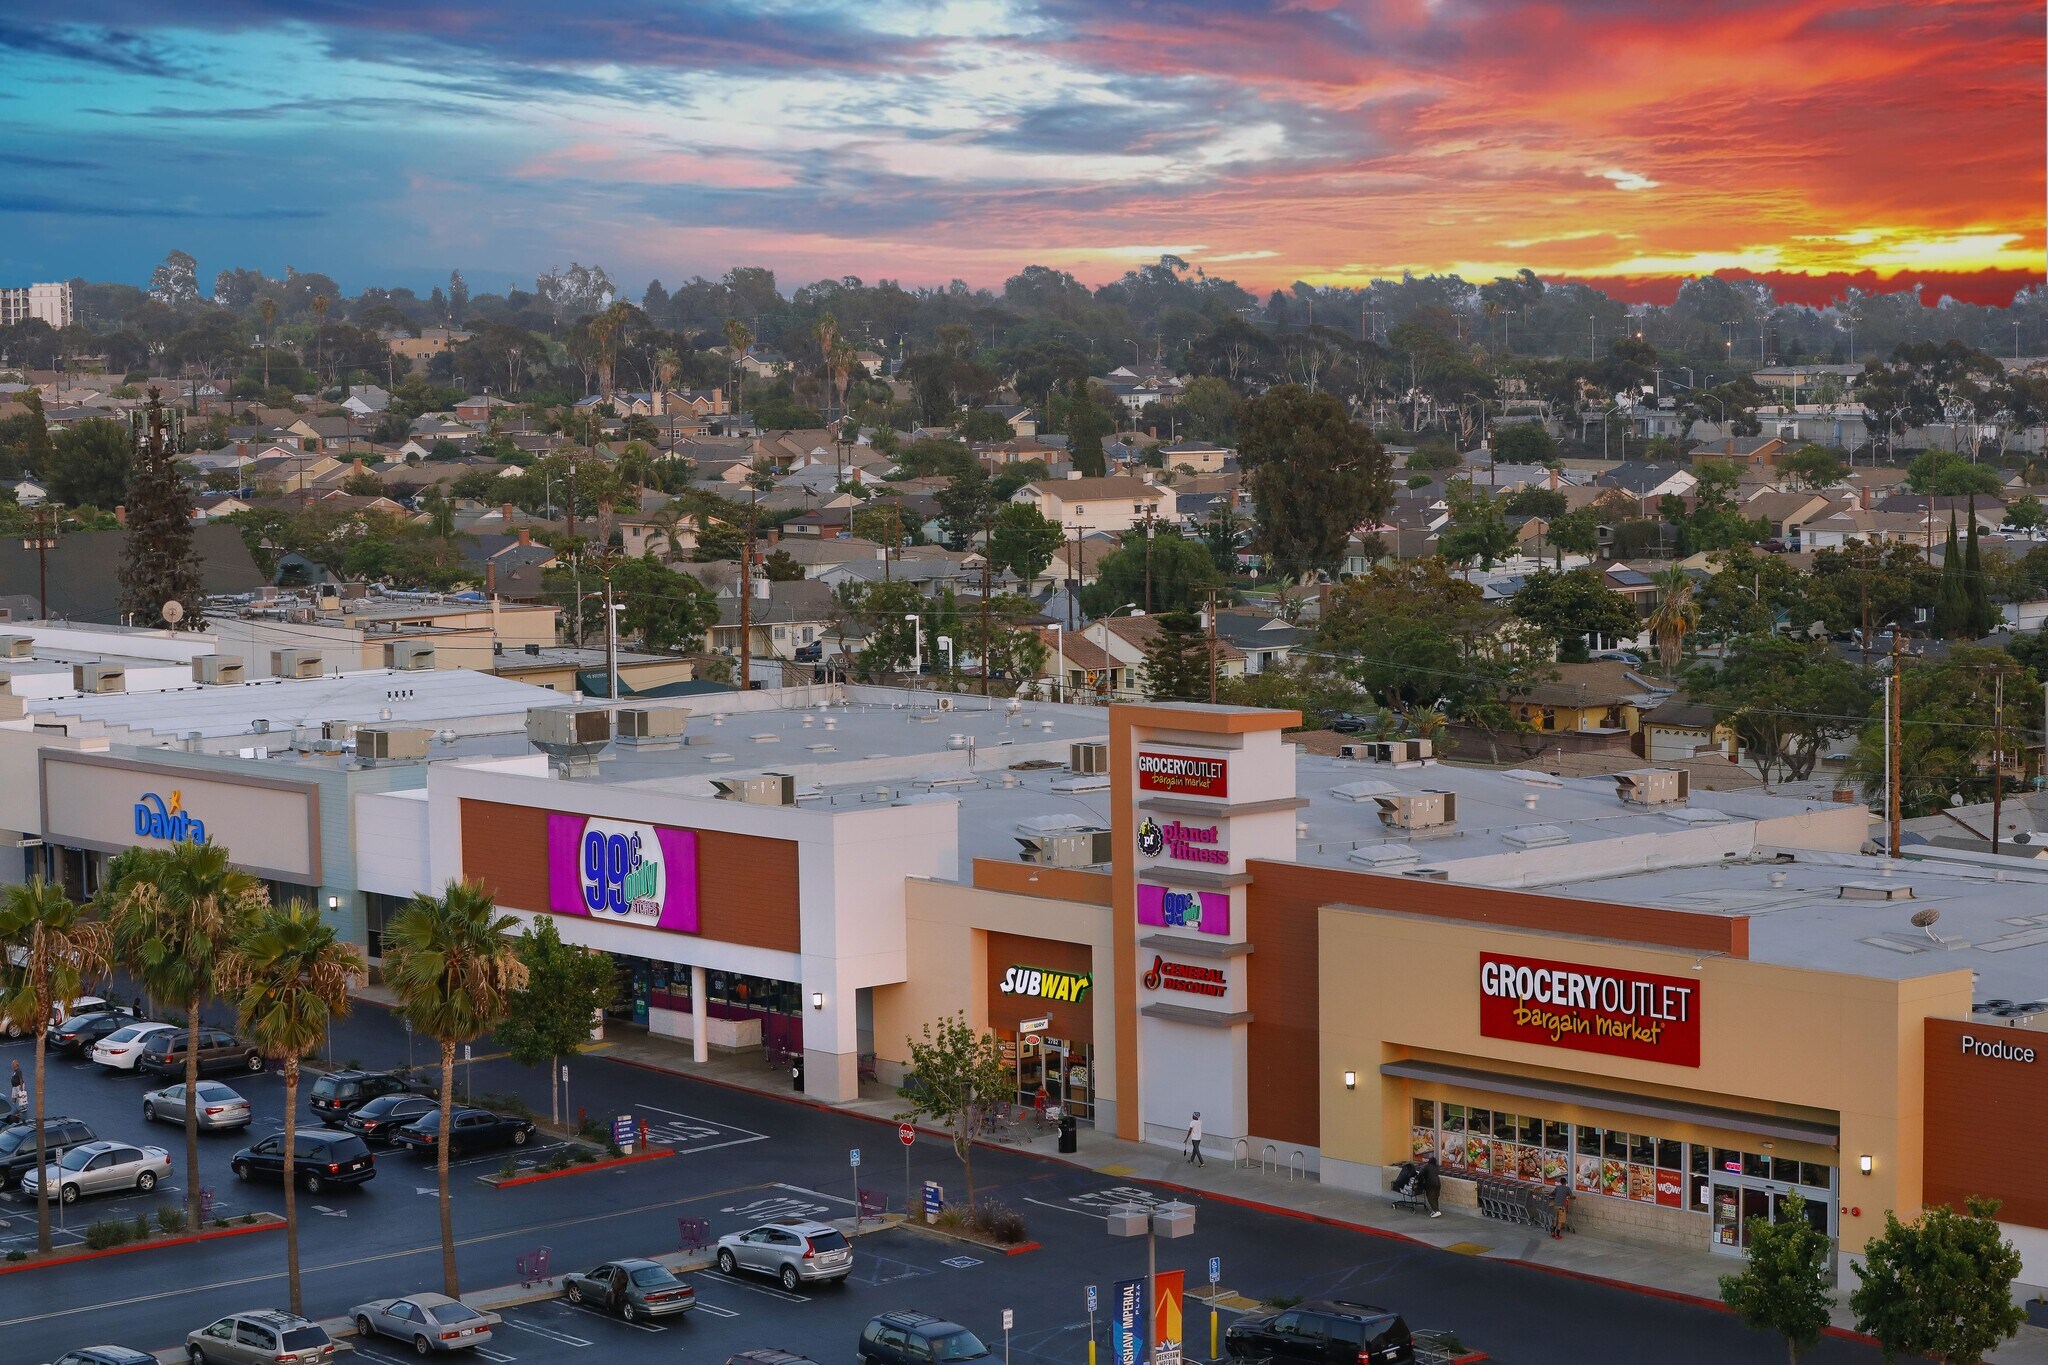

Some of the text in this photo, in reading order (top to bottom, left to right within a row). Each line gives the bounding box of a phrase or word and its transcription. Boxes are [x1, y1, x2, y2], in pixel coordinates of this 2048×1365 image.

[1184, 776, 1211, 788] market
[1162, 821, 1218, 844] planet
[1169, 840, 1229, 865] fitness
[632, 900, 660, 916] STORES
[1000, 967, 1090, 1002] SUBWAY
[1161, 962, 1227, 984] GENERAL
[1163, 978, 1228, 998] DISCOUNT
[1513, 994, 1662, 1044] bargain market
[1962, 1035, 2035, 1063] Produce
[900, 1129, 914, 1139] STOP
[1122, 1283, 1135, 1329] IMPERIAL
